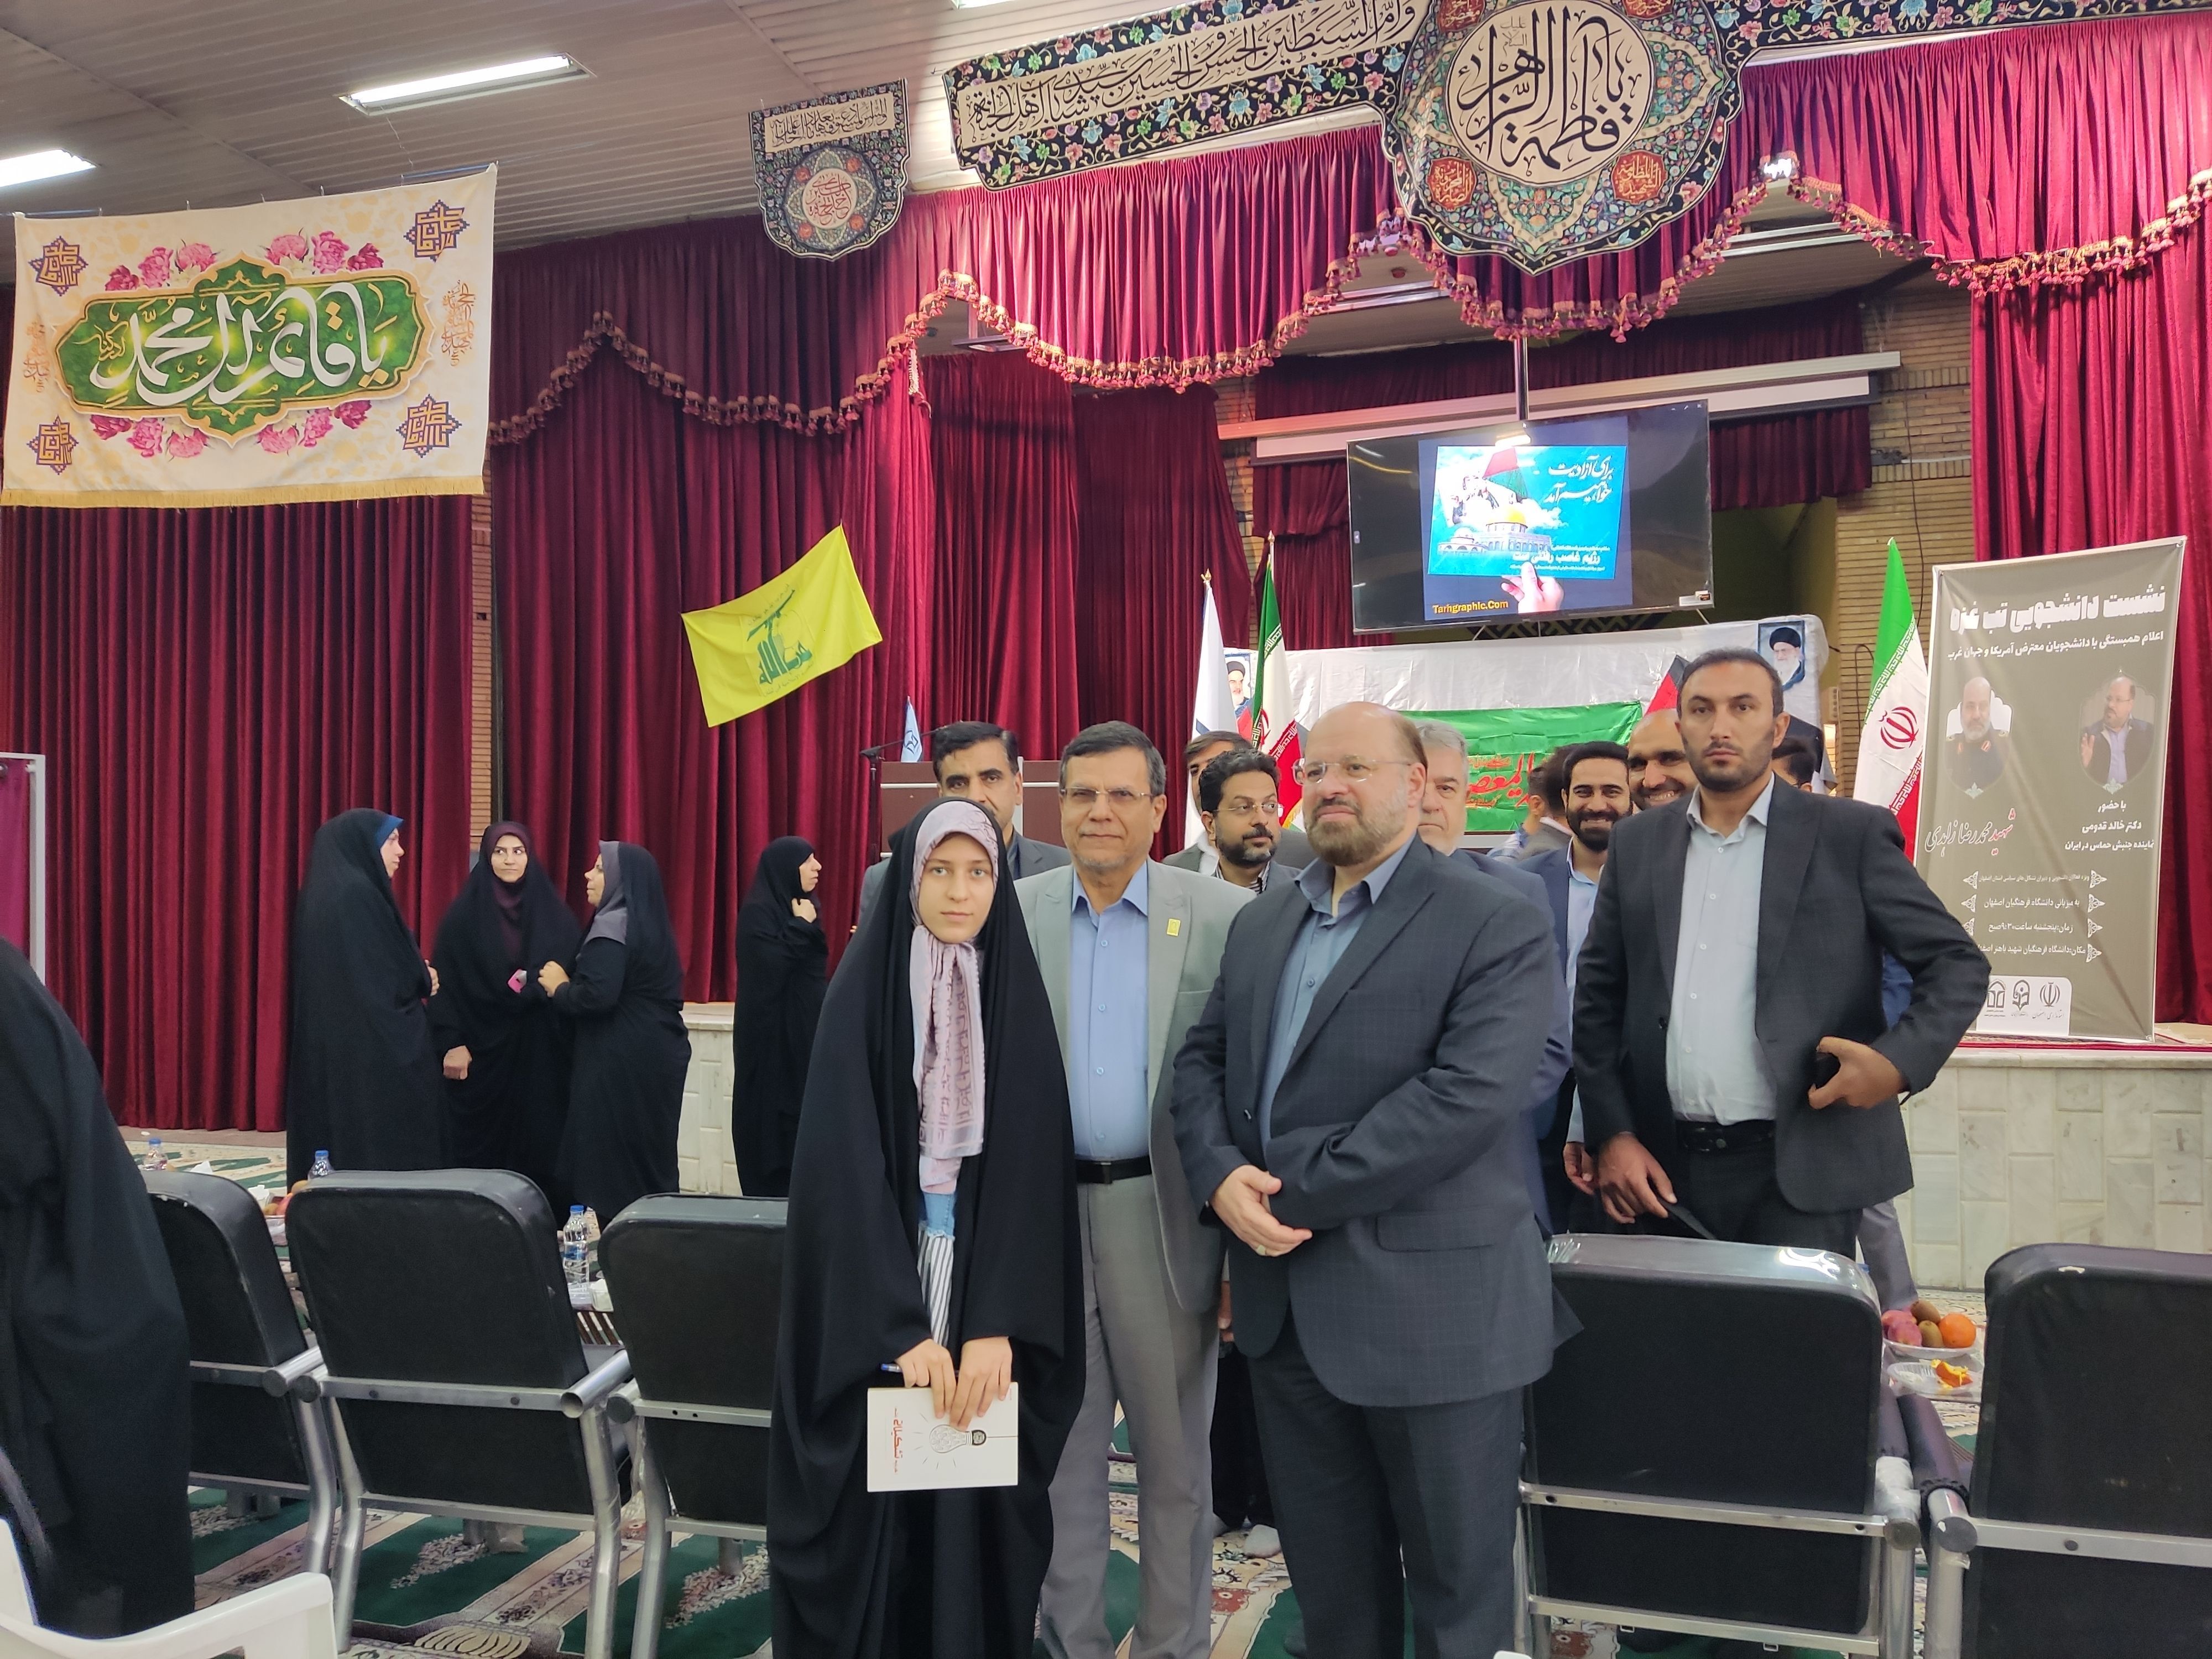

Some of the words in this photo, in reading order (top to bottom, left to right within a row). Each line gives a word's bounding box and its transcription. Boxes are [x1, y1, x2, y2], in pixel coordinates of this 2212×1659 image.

[1432, 599, 1509, 614] Tarhgraphic.Com
[2103, 583, 2166, 618] نشست
[1950, 601, 1980, 635] غزه
[1983, 602, 2008, 634] تب
[2010, 593, 2099, 633] دانشجویی
[2091, 637, 2098, 650] با
[2099, 634, 2140, 649] همبستگی
[2141, 630, 2164, 646] اعلام
[1964, 646, 1983, 658] جهان
[1990, 642, 2015, 658] آمریکا
[2015, 642, 2044, 656] معترض
[2046, 638, 2090, 653] دانشجویان
[1947, 646, 1963, 660] غرب
[1984, 648, 1989, 657] و
[2098, 800, 2119, 813] حضور
[2120, 800, 2127, 812] با
[2081, 821, 2108, 834] قدومی
[2108, 820, 2125, 830] خالد
[2125, 820, 2142, 833] دکتر
[2064, 841, 2081, 851] ایران
[2081, 842, 2089, 851] در
[2089, 841, 2111, 852] حماس
[2111, 839, 2132, 851] جنبش
[2133, 839, 2155, 851] نماینده
[1984, 898, 2005, 908] اصفهان
[2005, 897, 2031, 908] فرهنگیان
[2031, 898, 2054, 906] دانشگاه
[2054, 898, 2074, 909] میزبانی
